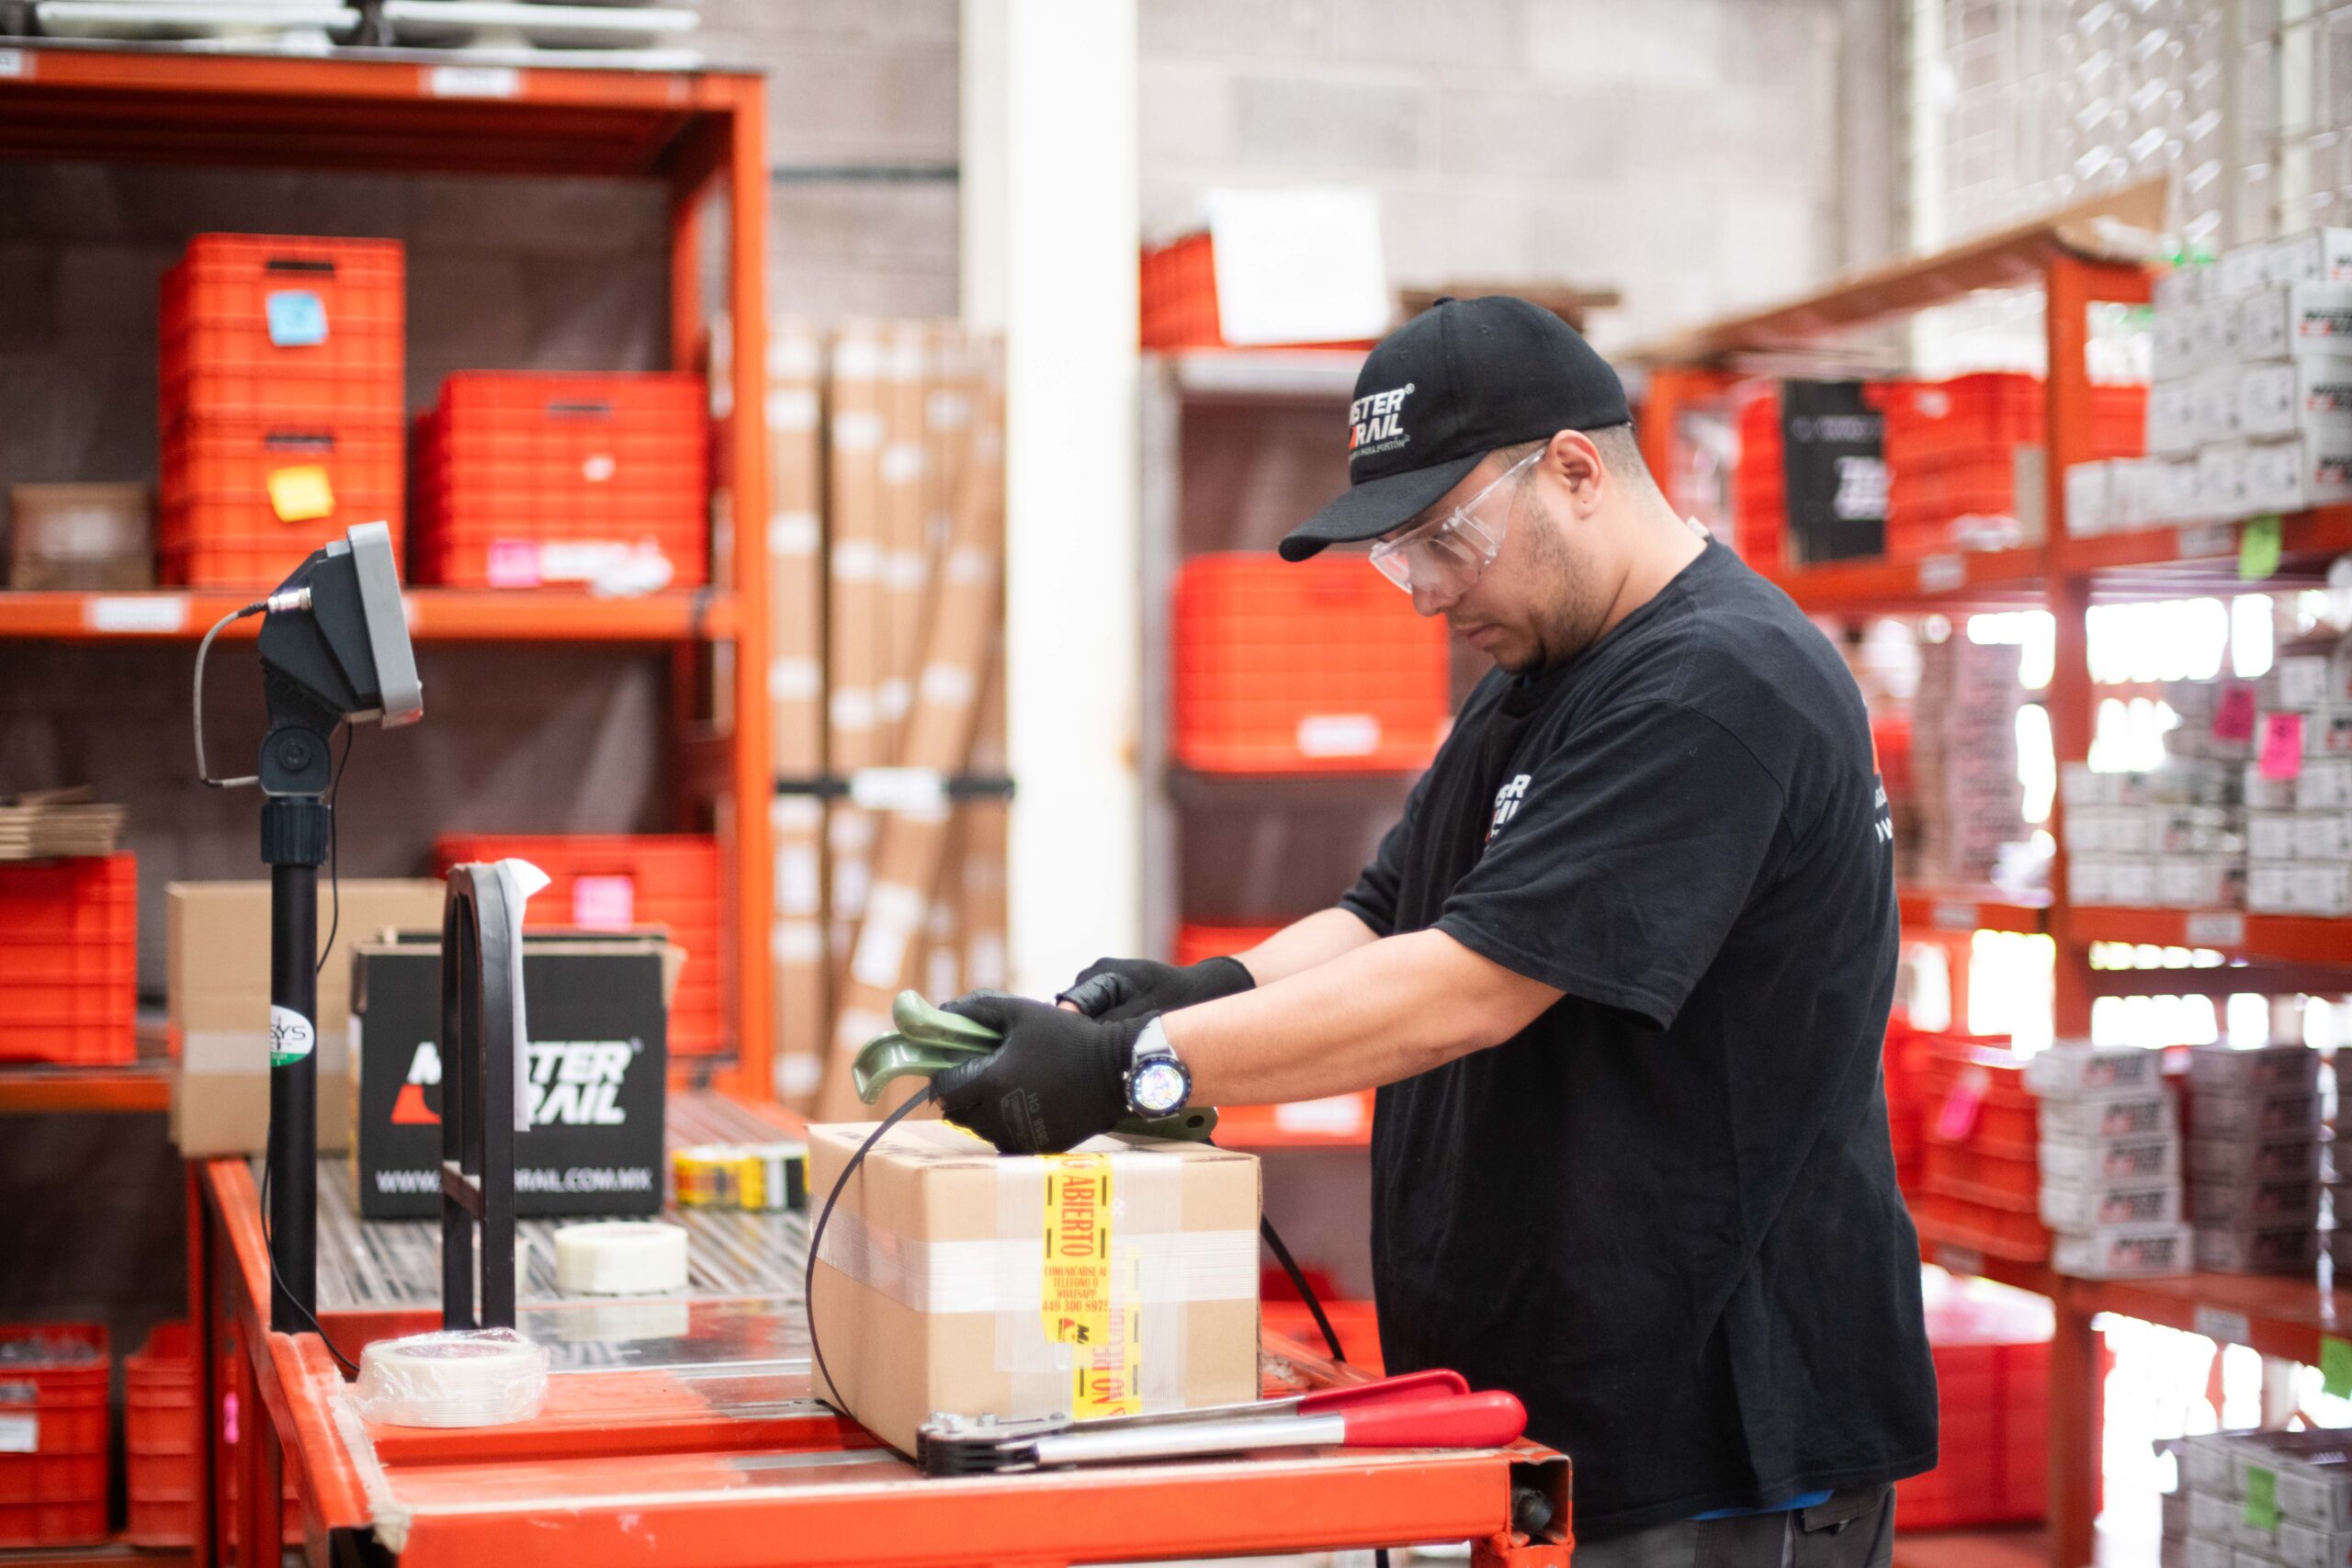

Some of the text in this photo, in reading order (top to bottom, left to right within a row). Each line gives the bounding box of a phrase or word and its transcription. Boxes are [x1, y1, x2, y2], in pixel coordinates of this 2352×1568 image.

[1060, 1175, 1095, 1257] ABIERTO
[1044, 1266, 1096, 1277] COMUNICARSE
[1053, 1278, 1091, 1288] TELEFONO
[1057, 1289, 1097, 1299] WHATSAPP
[1042, 1300, 1061, 1313] 449
[1063, 1300, 1082, 1313] 300
[1091, 1378, 1125, 1404] NO
